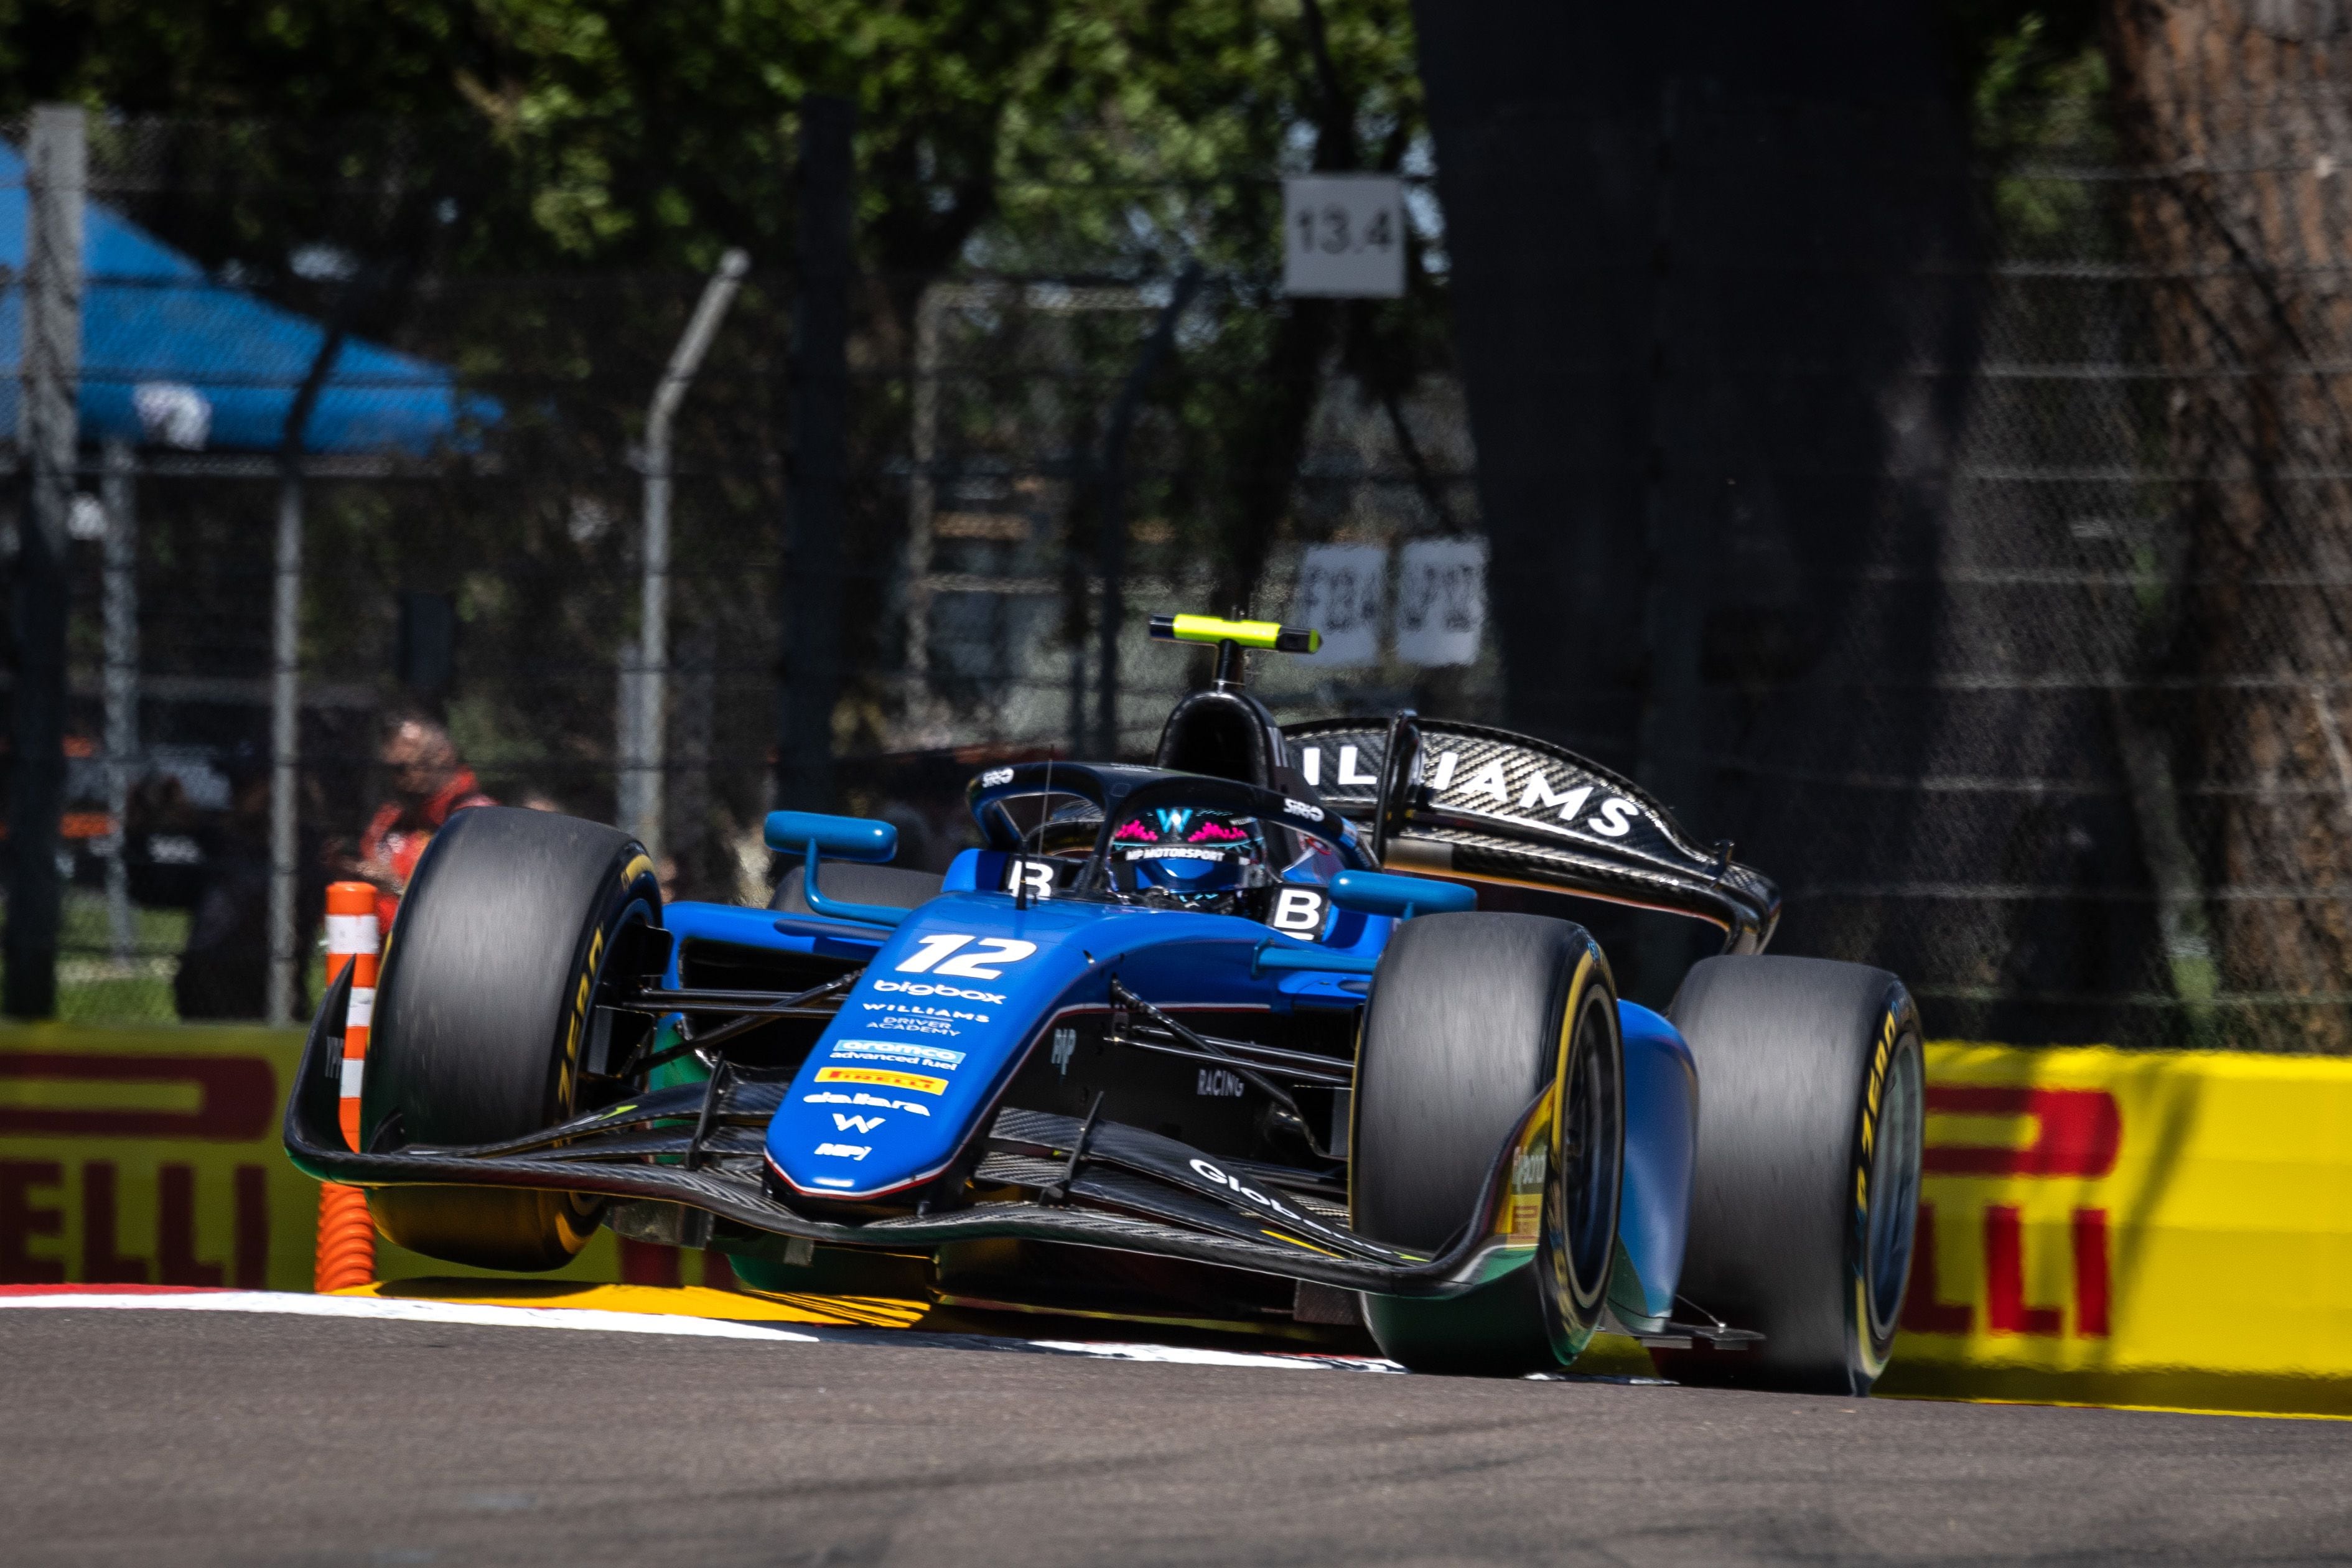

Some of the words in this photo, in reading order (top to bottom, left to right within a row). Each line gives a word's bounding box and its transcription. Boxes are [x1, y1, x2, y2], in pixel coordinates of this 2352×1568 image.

[1303, 745, 1639, 836] ILIAMS
[1156, 808, 1193, 833] W
[1144, 847, 1225, 861] MOTORSPORT
[1273, 888, 1322, 930] B
[895, 934, 1038, 980] 12
[873, 979, 1007, 1004] bigbox
[862, 1003, 990, 1023] WILLIAMS
[883, 1016, 952, 1029] DRIVER
[866, 1022, 961, 1037] ACADEMY
[829, 1051, 920, 1065] advanced
[921, 1058, 958, 1071] fuel
[842, 1040, 957, 1061] aramco
[828, 1070, 935, 1089] PIRELLI
[1197, 1068, 1244, 1097] RACING
[803, 1091, 931, 1117] dallara
[832, 1113, 887, 1134] W
